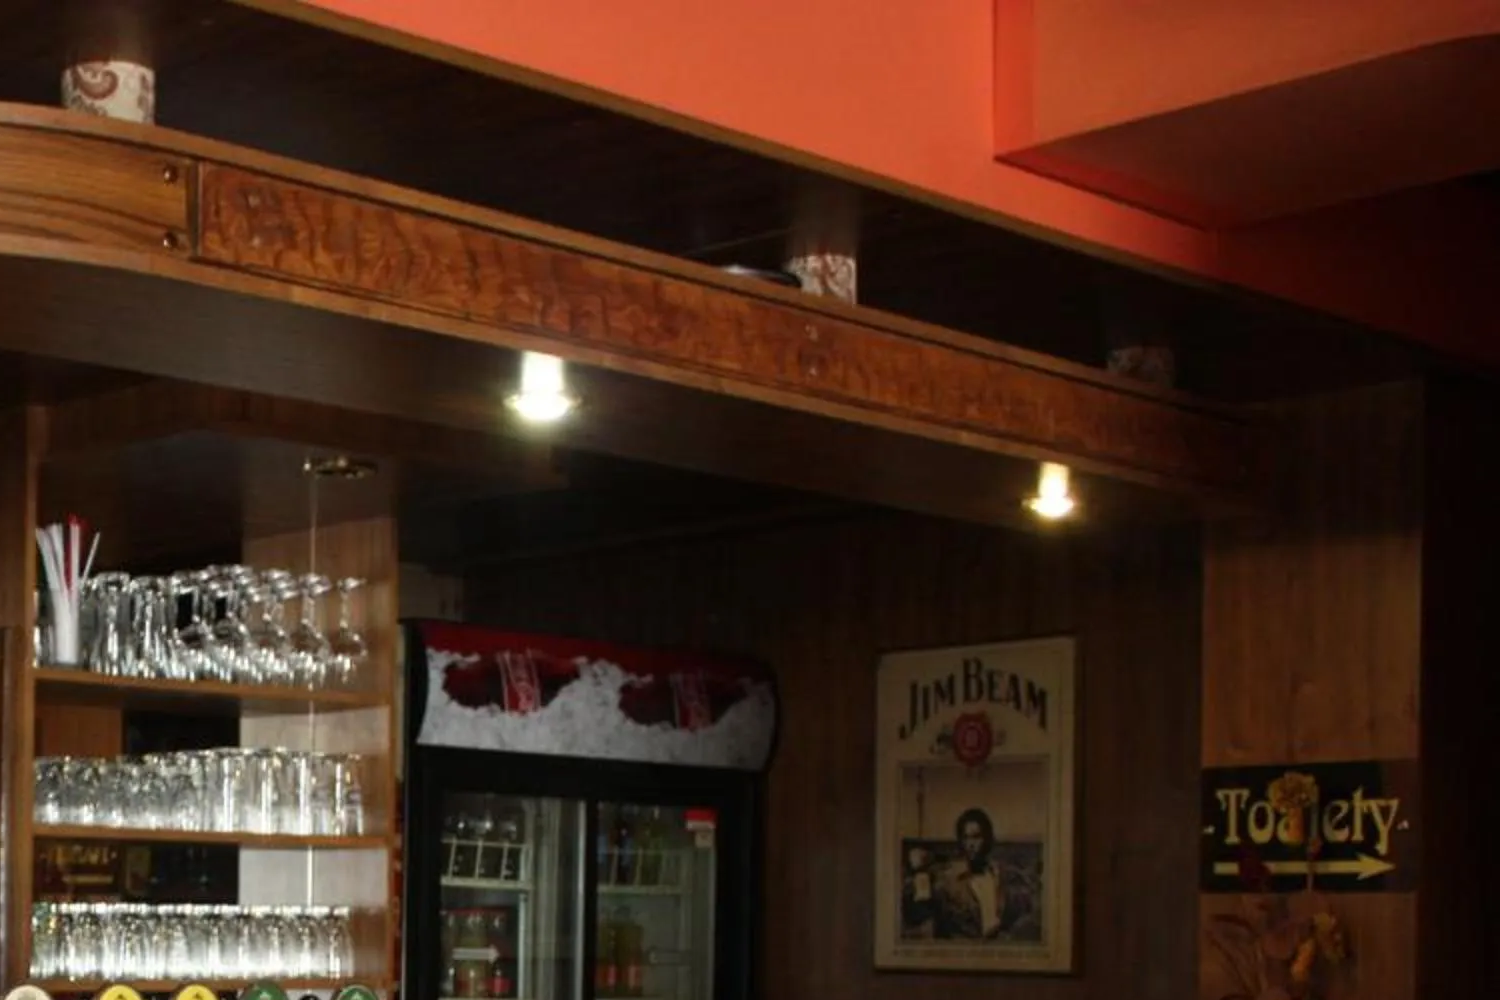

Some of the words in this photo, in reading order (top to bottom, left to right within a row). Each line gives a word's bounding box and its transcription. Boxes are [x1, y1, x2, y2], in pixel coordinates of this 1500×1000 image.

[899, 672, 956, 741] JIM
[961, 657, 1049, 733] BEAM
[1215, 784, 1400, 856] Toaety
